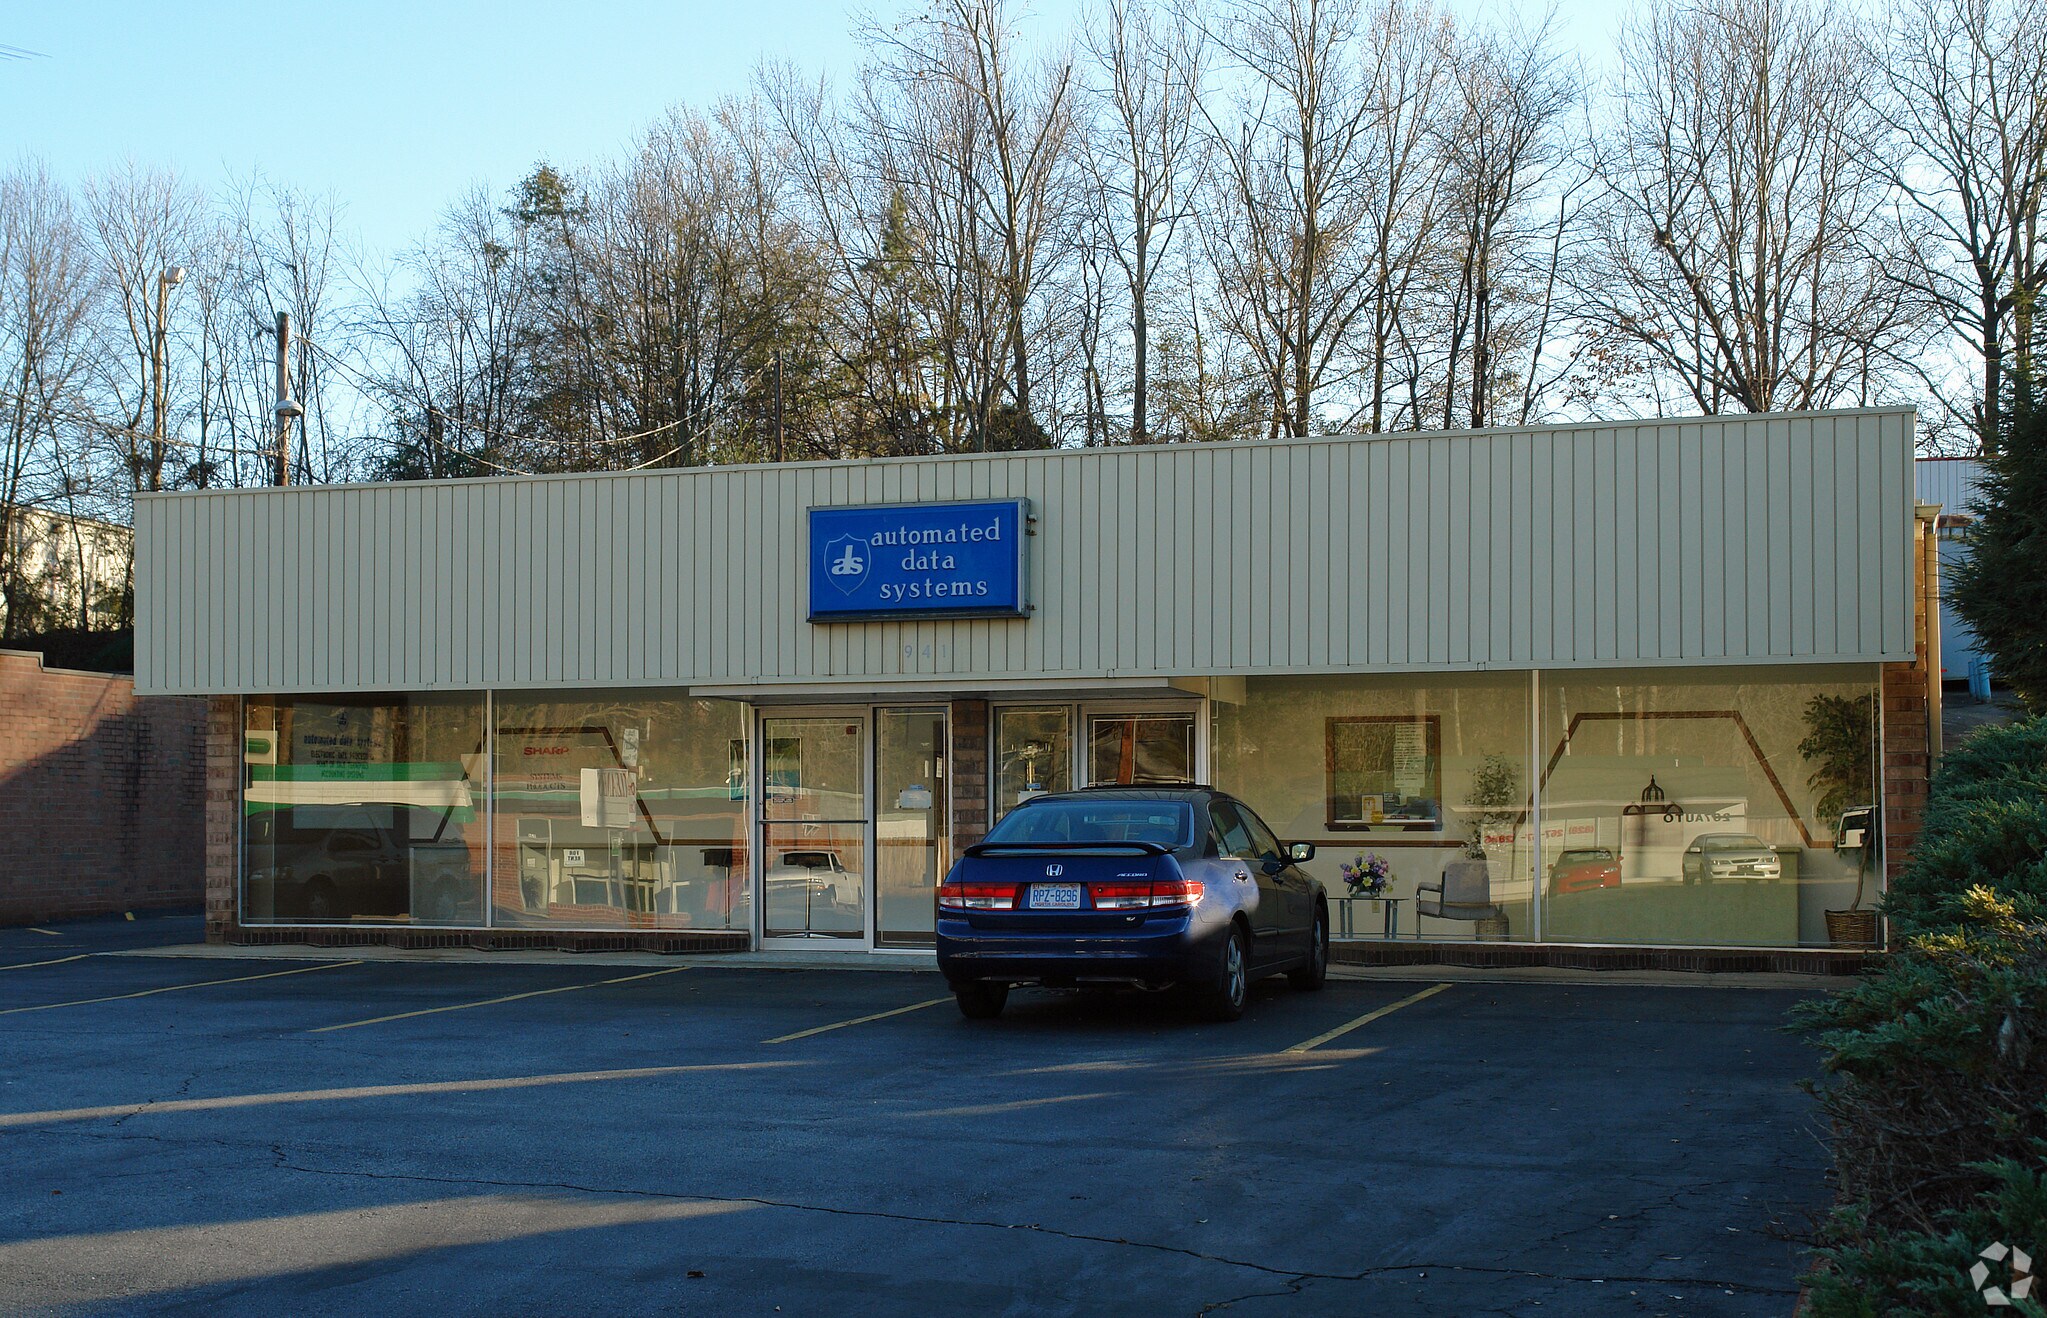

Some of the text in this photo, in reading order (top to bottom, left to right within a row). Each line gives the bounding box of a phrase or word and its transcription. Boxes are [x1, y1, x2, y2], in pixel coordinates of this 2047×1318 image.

[870, 517, 1001, 546] automated
[901, 548, 955, 571] data
[879, 577, 988, 603] systems
[904, 644, 946, 658] 941
[523, 747, 569, 756] SHARP
[1032, 889, 1078, 902] RPZ-8296
